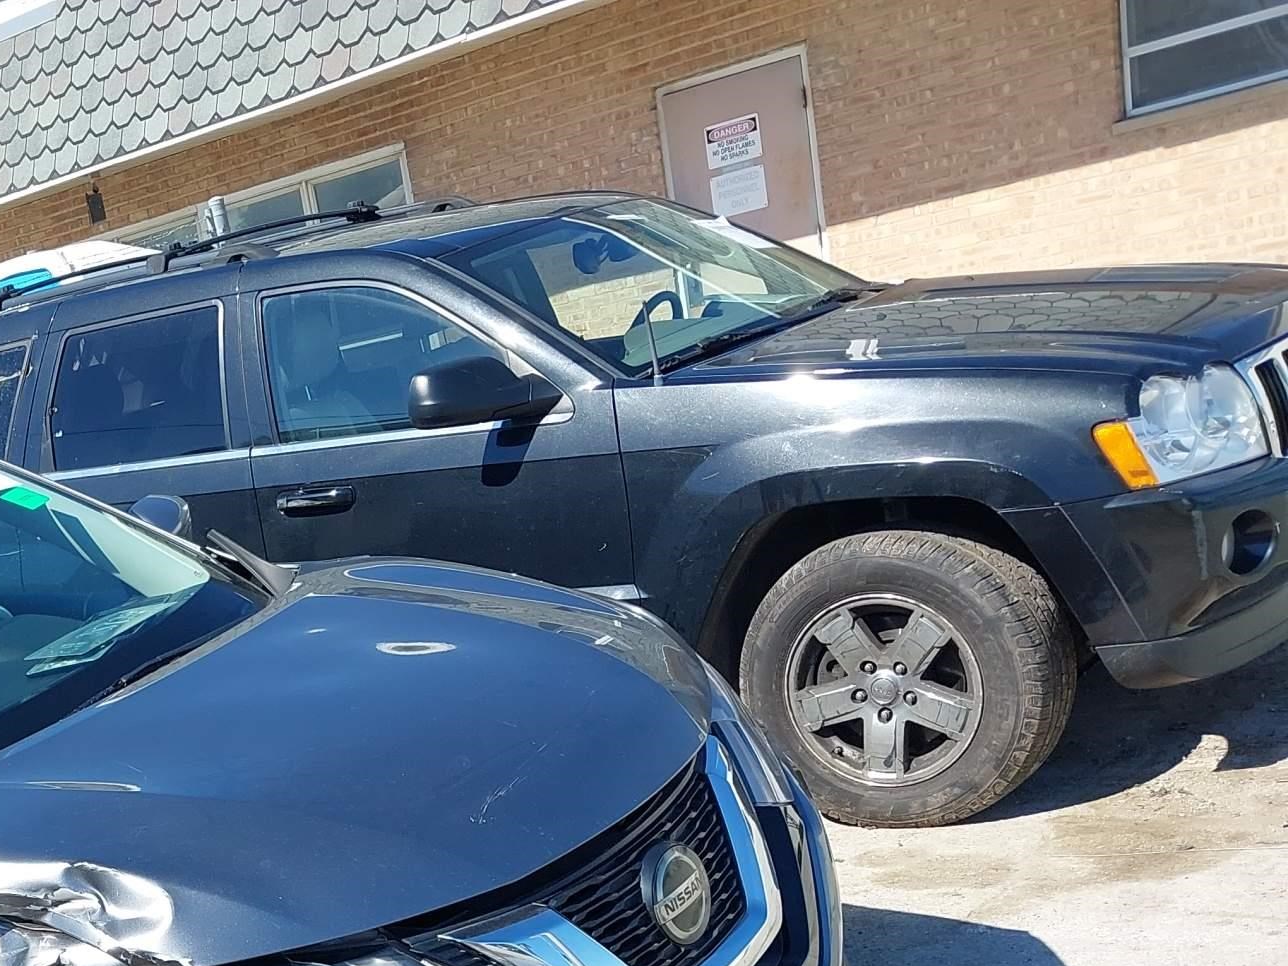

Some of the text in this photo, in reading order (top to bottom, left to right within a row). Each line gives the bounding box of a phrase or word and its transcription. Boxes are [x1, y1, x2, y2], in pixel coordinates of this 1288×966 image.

[713, 122, 749, 139] DANGER
[712, 139, 756, 157] NO OPEN FLAMES
[717, 134, 749, 149] NO SMOKING
[729, 150, 749, 160] SPARKS
[663, 875, 702, 916] NISSAN
